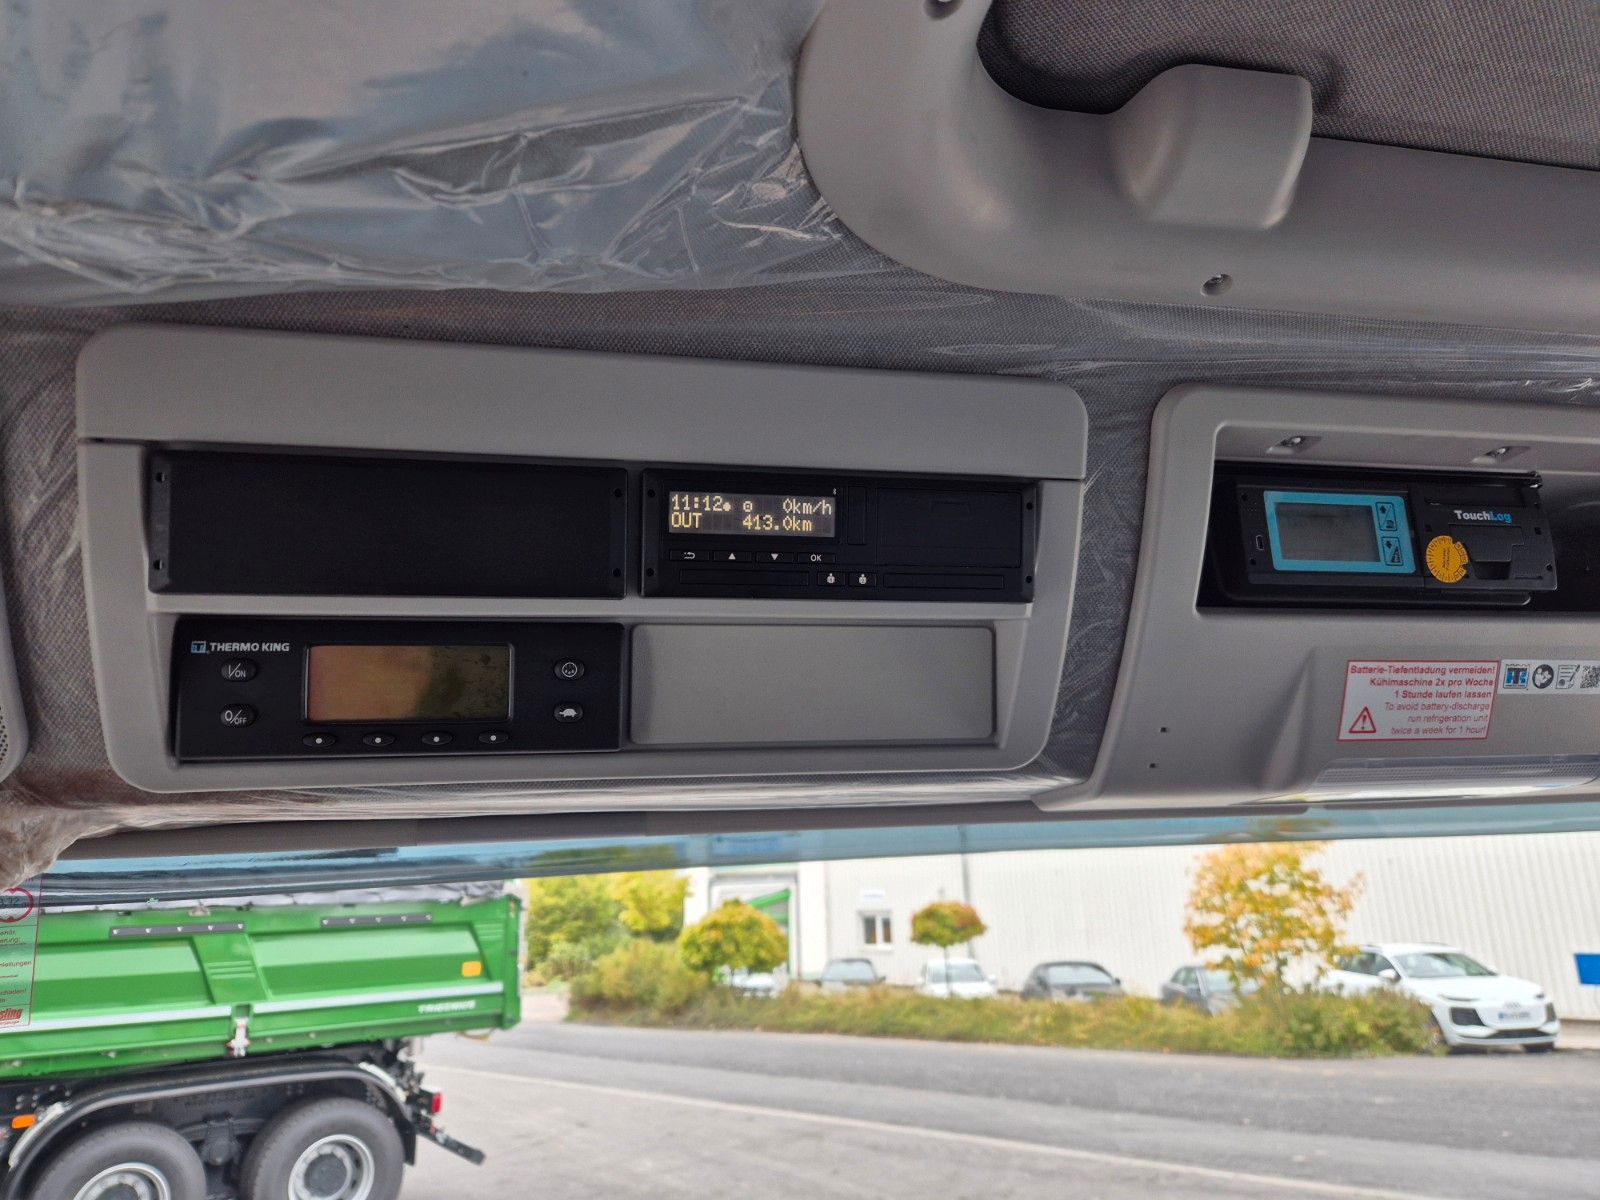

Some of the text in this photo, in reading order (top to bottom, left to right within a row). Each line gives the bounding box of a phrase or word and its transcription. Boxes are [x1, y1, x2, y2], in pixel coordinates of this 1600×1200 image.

[671, 494, 832, 516] 11:12 0km/h
[671, 512, 812, 532] OUT 413.0km
[1453, 510, 1512, 524] TouchLog
[810, 554, 822, 562] OK
[209, 642, 290, 652] THERMO KING
[1350, 665, 1495, 676] Batterie-Tiefentladung vermeiden!
[1370, 677, 1433, 686] Kühlmaschine
[1435, 678, 1445, 686] 2x
[1447, 679, 1462, 688] pro
[1465, 678, 1494, 686] Woche
[1394, 690, 1492, 698] 1 Stunde laufen lassen
[1384, 702, 1490, 712] To avoid battery-discharge
[1423, 714, 1471, 724] refrigeration
[1473, 714, 1488, 722] unit
[1391, 727, 1412, 735] twice
[1422, 727, 1443, 735] week
[1445, 726, 1456, 735] for
